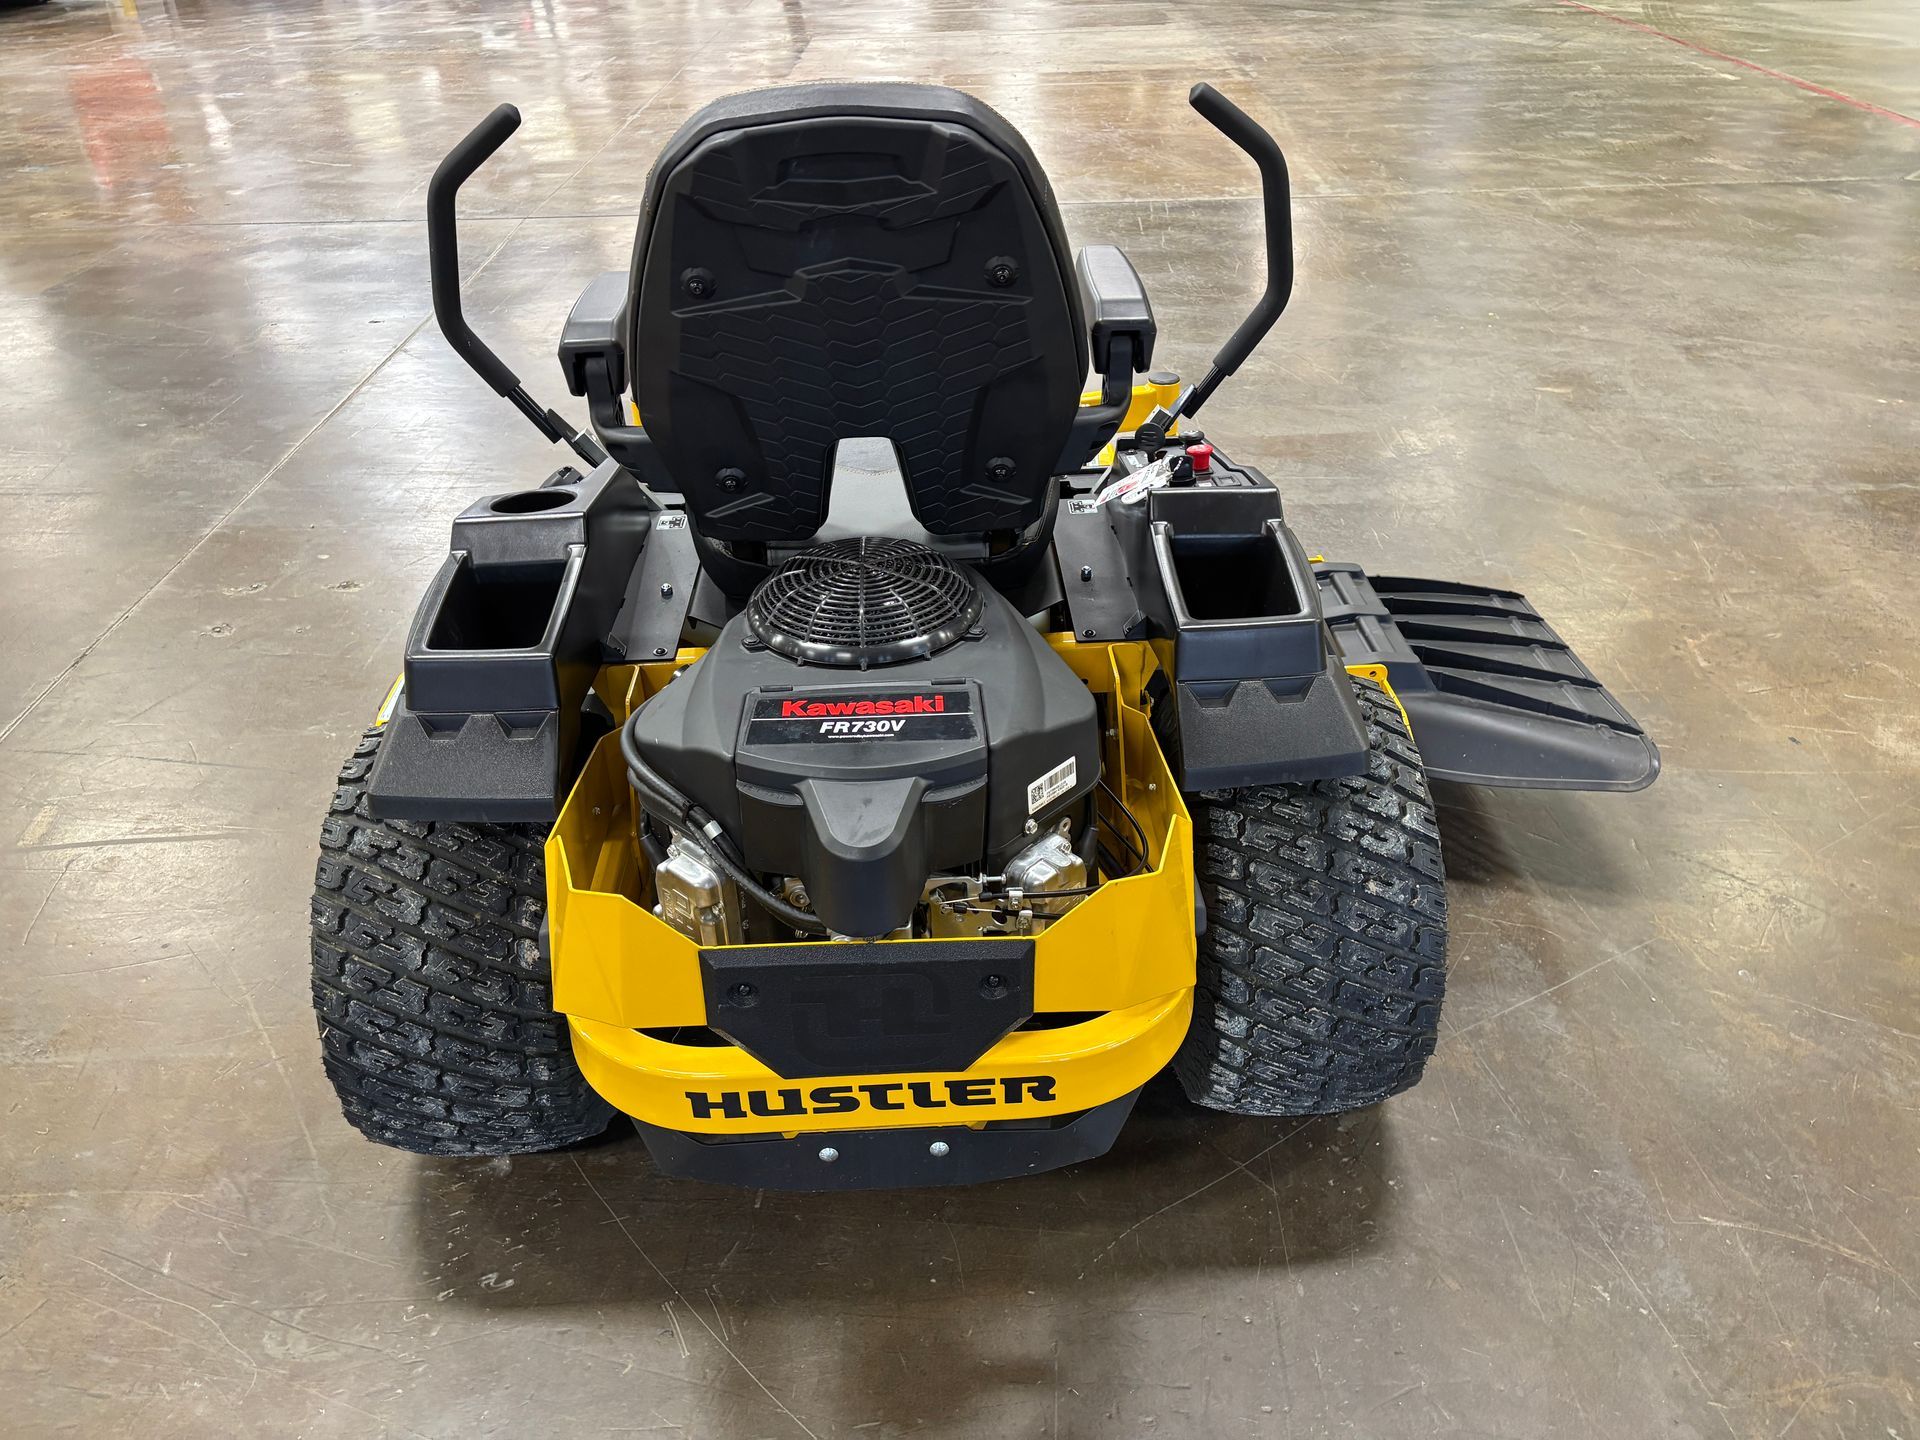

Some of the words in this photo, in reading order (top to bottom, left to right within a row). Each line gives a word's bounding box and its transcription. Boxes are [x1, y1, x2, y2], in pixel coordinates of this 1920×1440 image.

[782, 696, 944, 716] Kawasaki
[819, 719, 906, 733] FR730V
[685, 1075, 1056, 1118] HUSTLER
